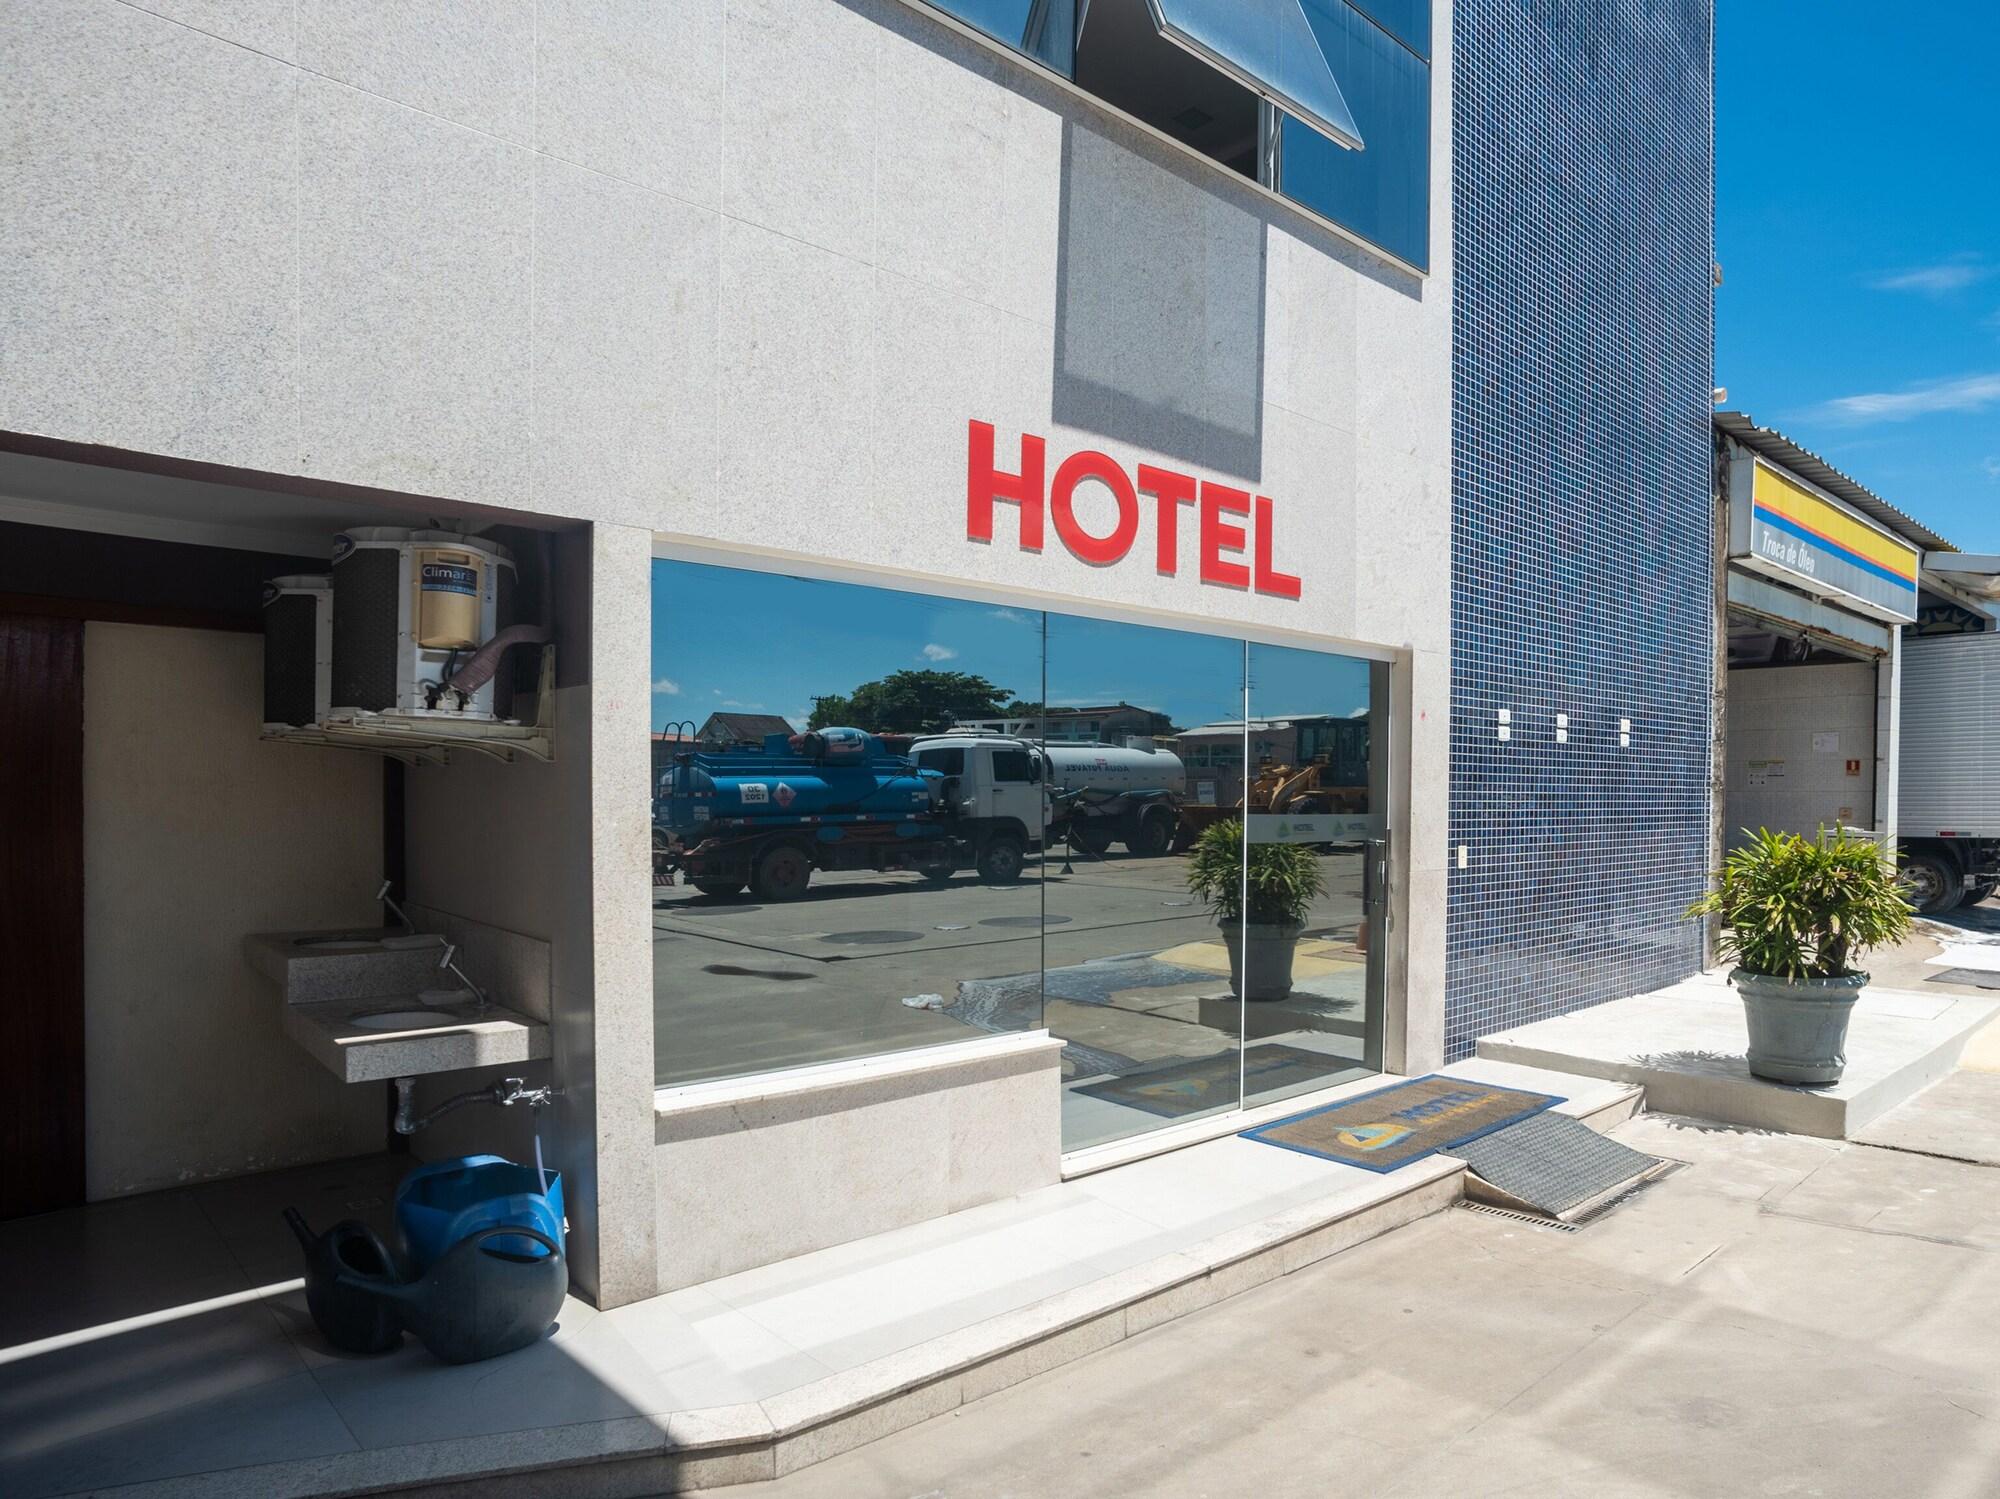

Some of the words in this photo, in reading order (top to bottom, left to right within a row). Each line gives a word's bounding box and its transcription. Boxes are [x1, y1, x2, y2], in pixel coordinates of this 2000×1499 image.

[967, 419, 1302, 599] HOTEL
[1762, 530, 1786, 561] Troca
[1786, 543, 1797, 565] de
[1797, 542, 1816, 573] Óleo
